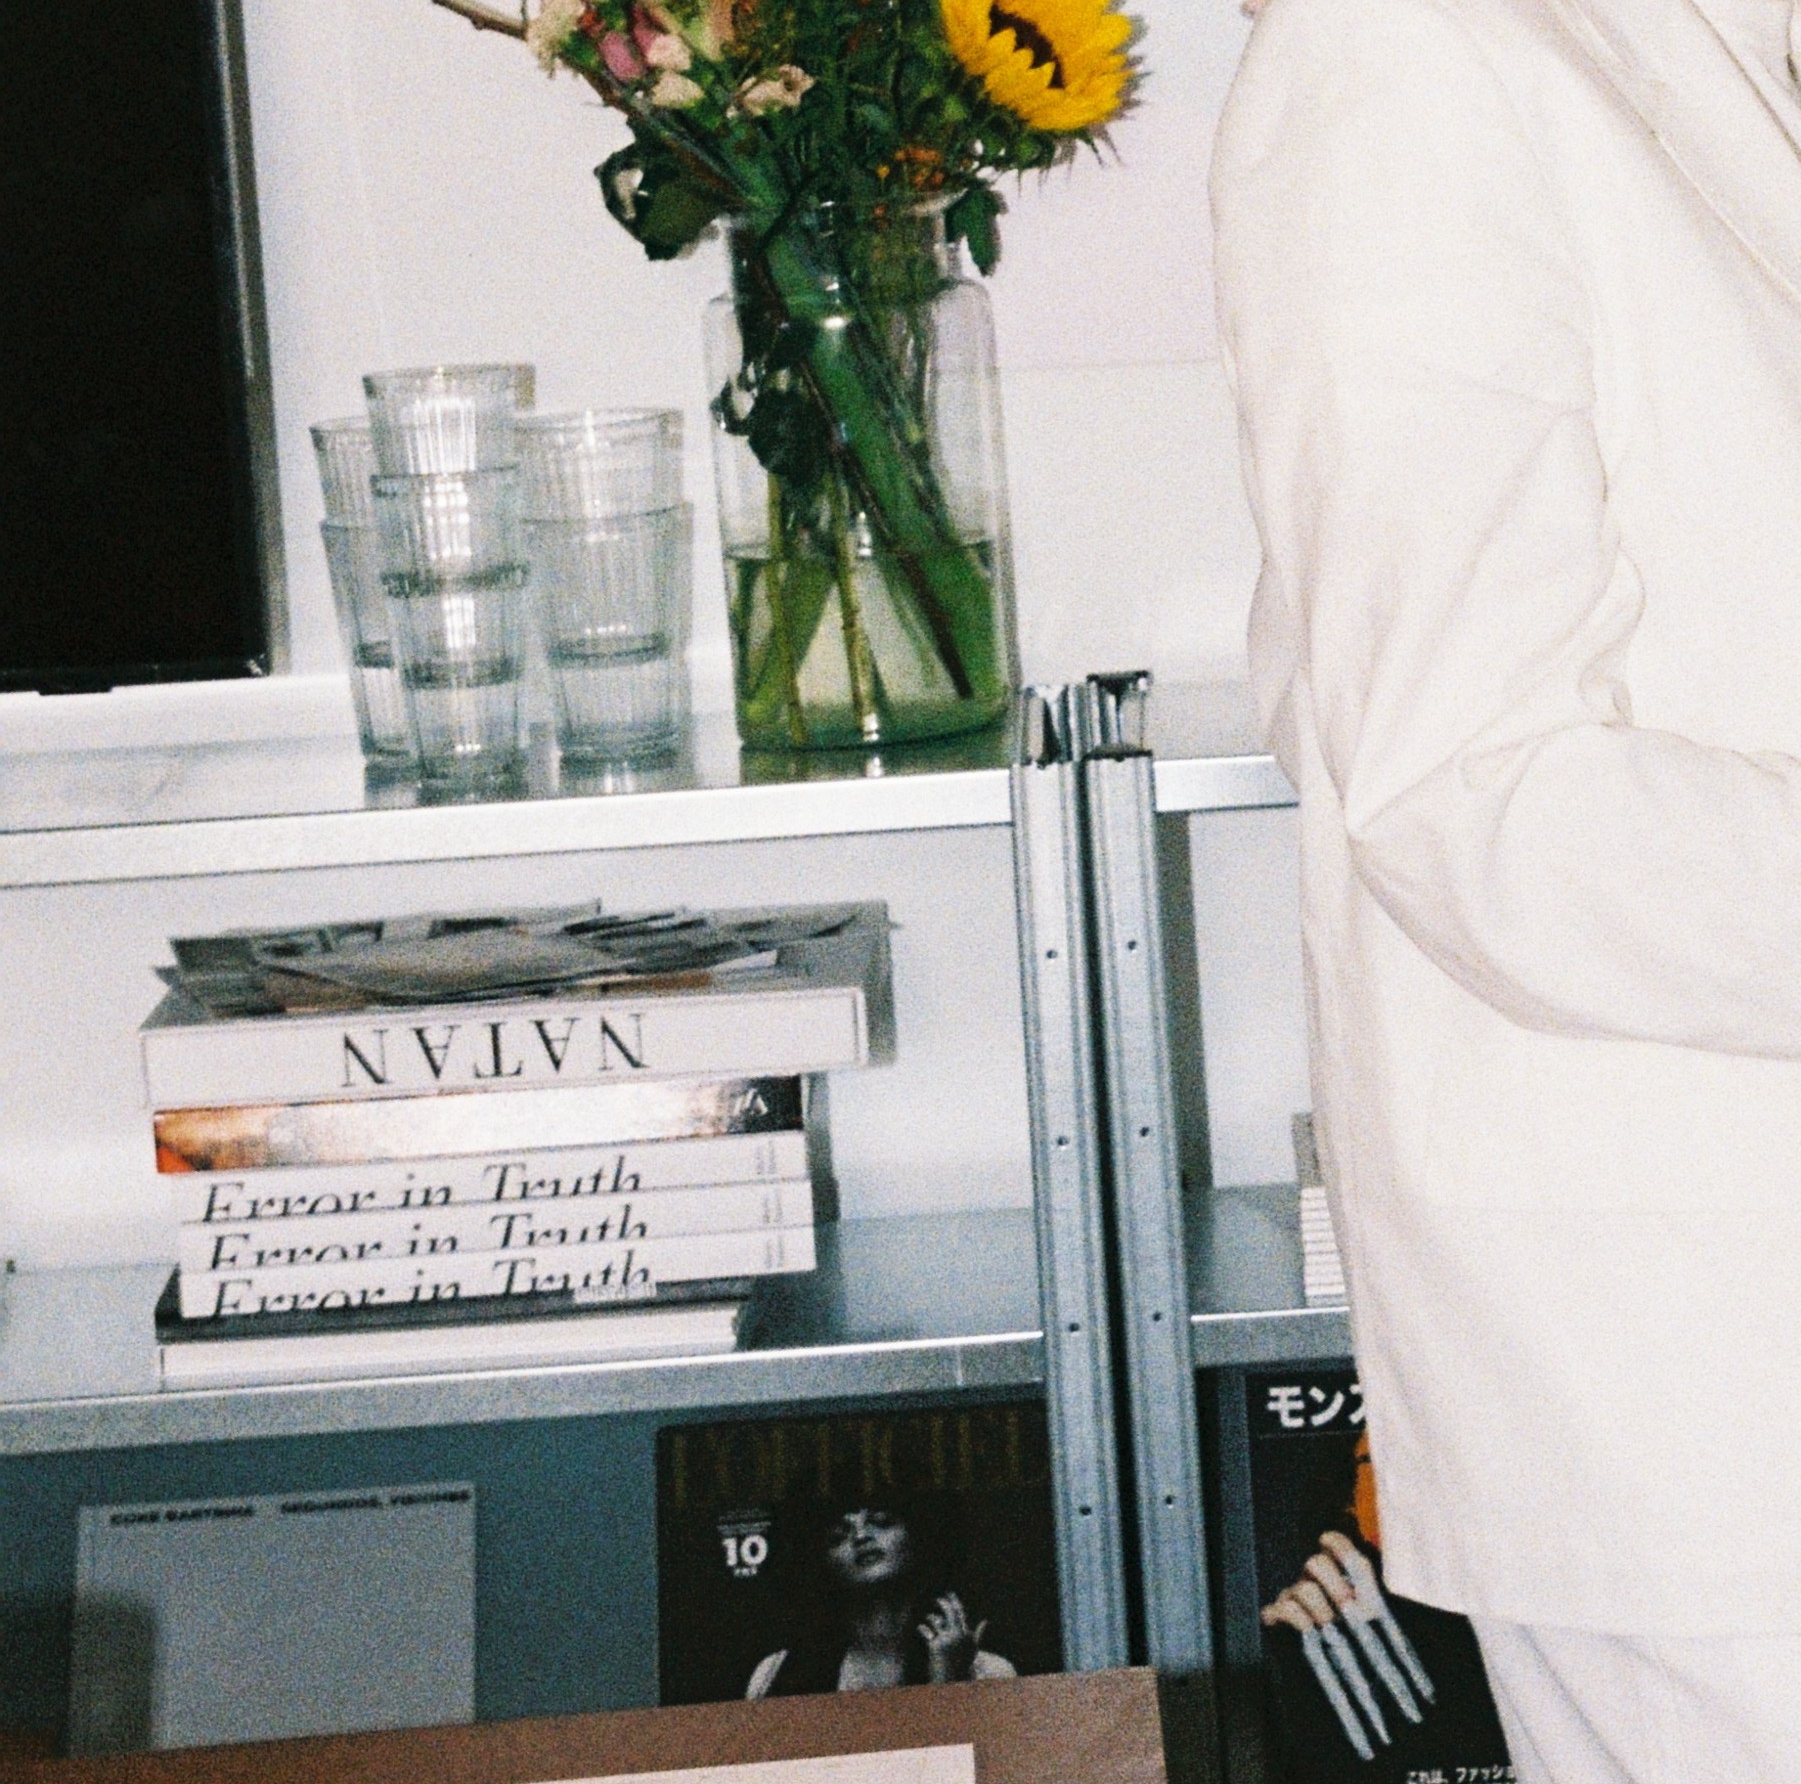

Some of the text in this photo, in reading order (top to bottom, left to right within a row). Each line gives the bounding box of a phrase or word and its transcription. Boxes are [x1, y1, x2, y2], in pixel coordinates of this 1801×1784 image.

[342, 1014, 650, 1087] NATAN
[202, 1155, 641, 1223] Error in Truth
[211, 1203, 647, 1270] Error in Truth
[215, 1278, 386, 1316] Error
[410, 1268, 462, 1301] in
[493, 1248, 651, 1295] Truth
[722, 1534, 768, 1567] 10
